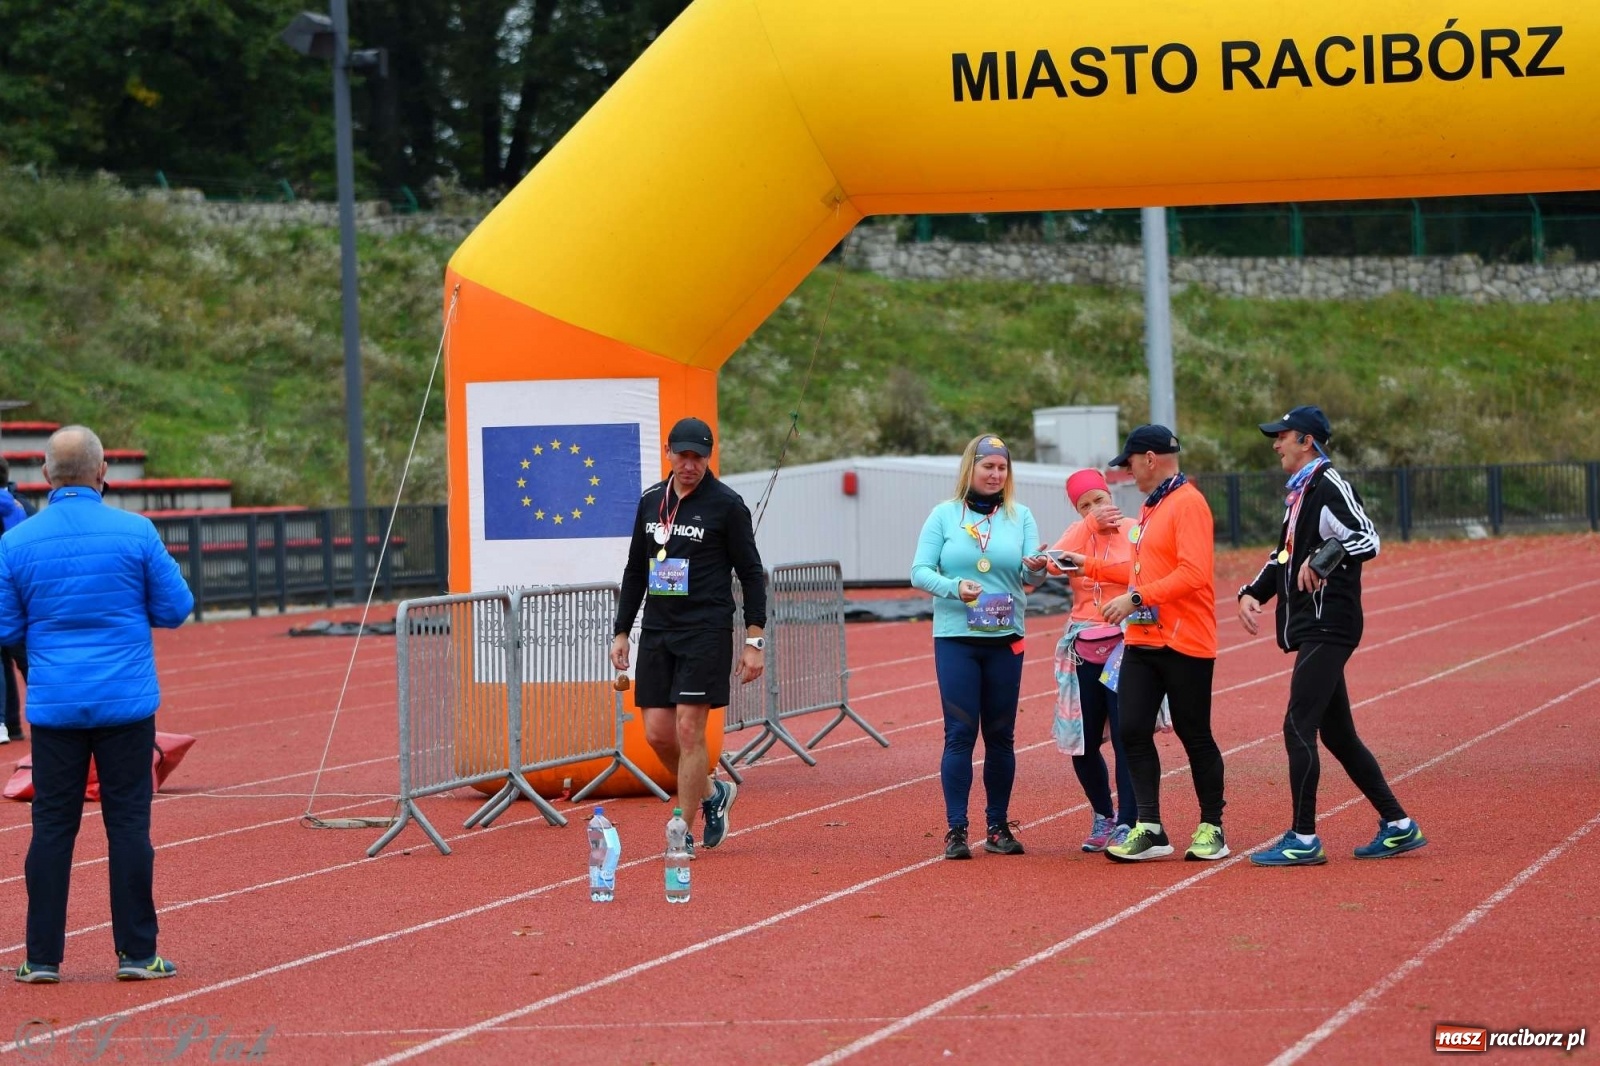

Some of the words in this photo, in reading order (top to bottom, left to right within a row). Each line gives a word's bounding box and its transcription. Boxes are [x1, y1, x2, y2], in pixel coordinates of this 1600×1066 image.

[951, 42, 1198, 102] MIASTO
[1221, 18, 1565, 91] RACIBÓRZ
[645, 522, 705, 540] DECTHLON
[667, 583, 684, 591] 222
[1136, 611, 1153, 620] 225
